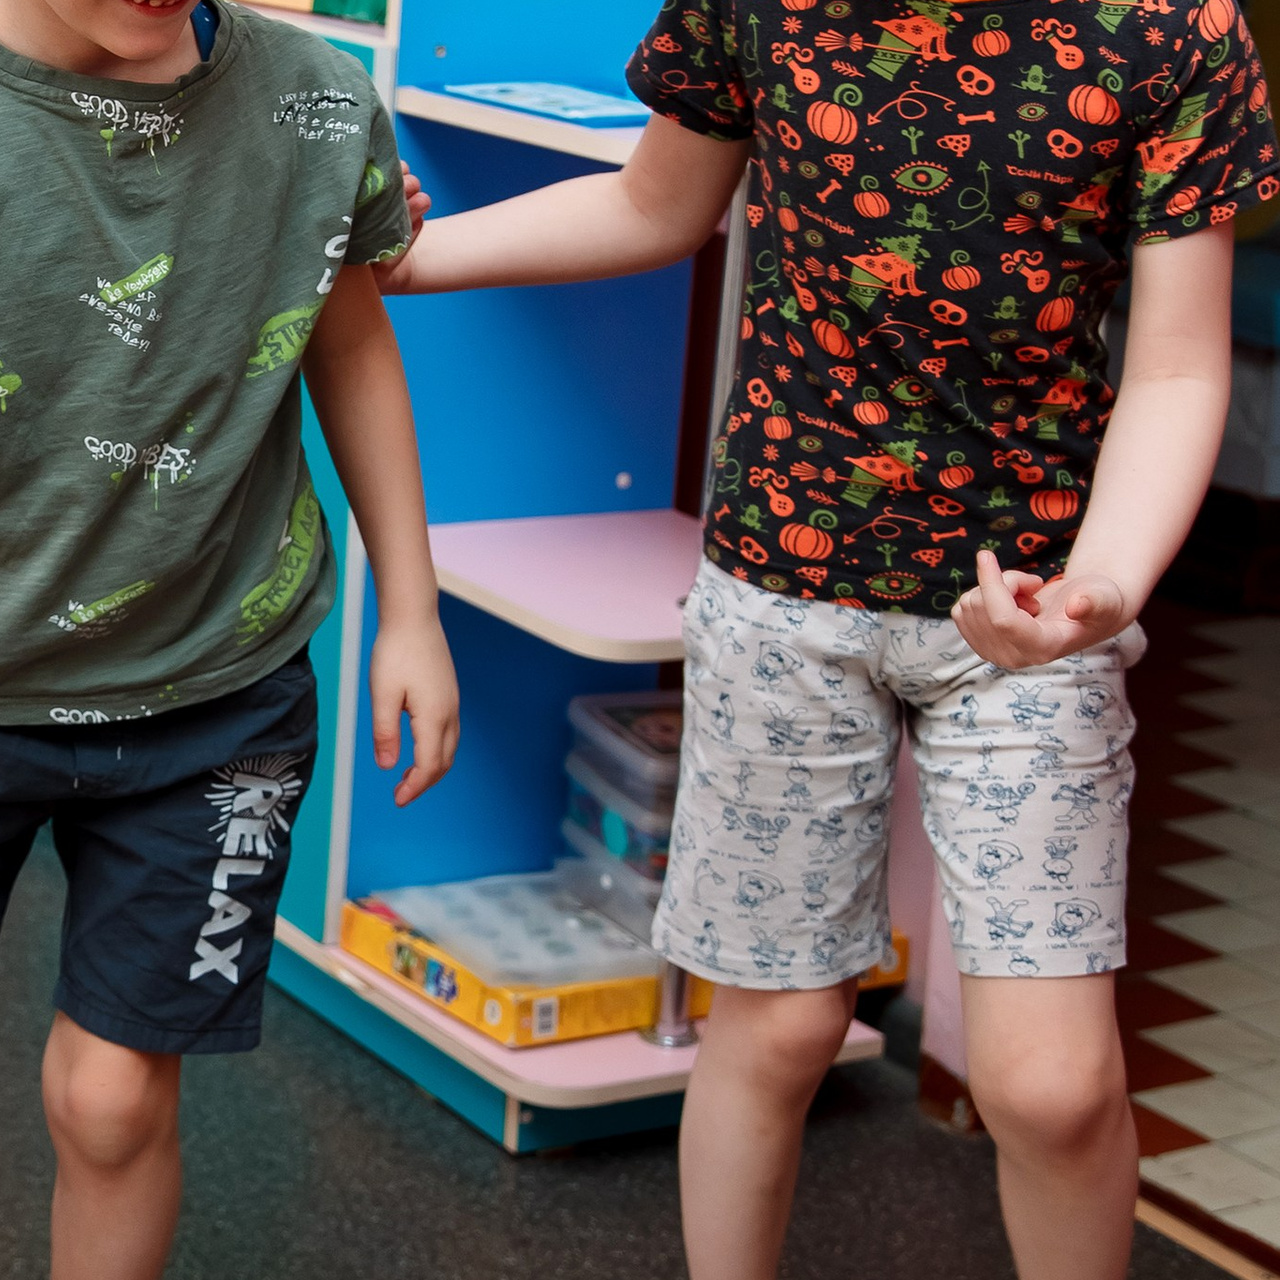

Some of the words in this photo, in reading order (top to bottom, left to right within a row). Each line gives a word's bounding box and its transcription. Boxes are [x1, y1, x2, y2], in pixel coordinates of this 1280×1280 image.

[70, 91, 128, 125] GOOD
[84, 435, 137, 464] GOOD
[189, 771, 284, 985] RELAX
